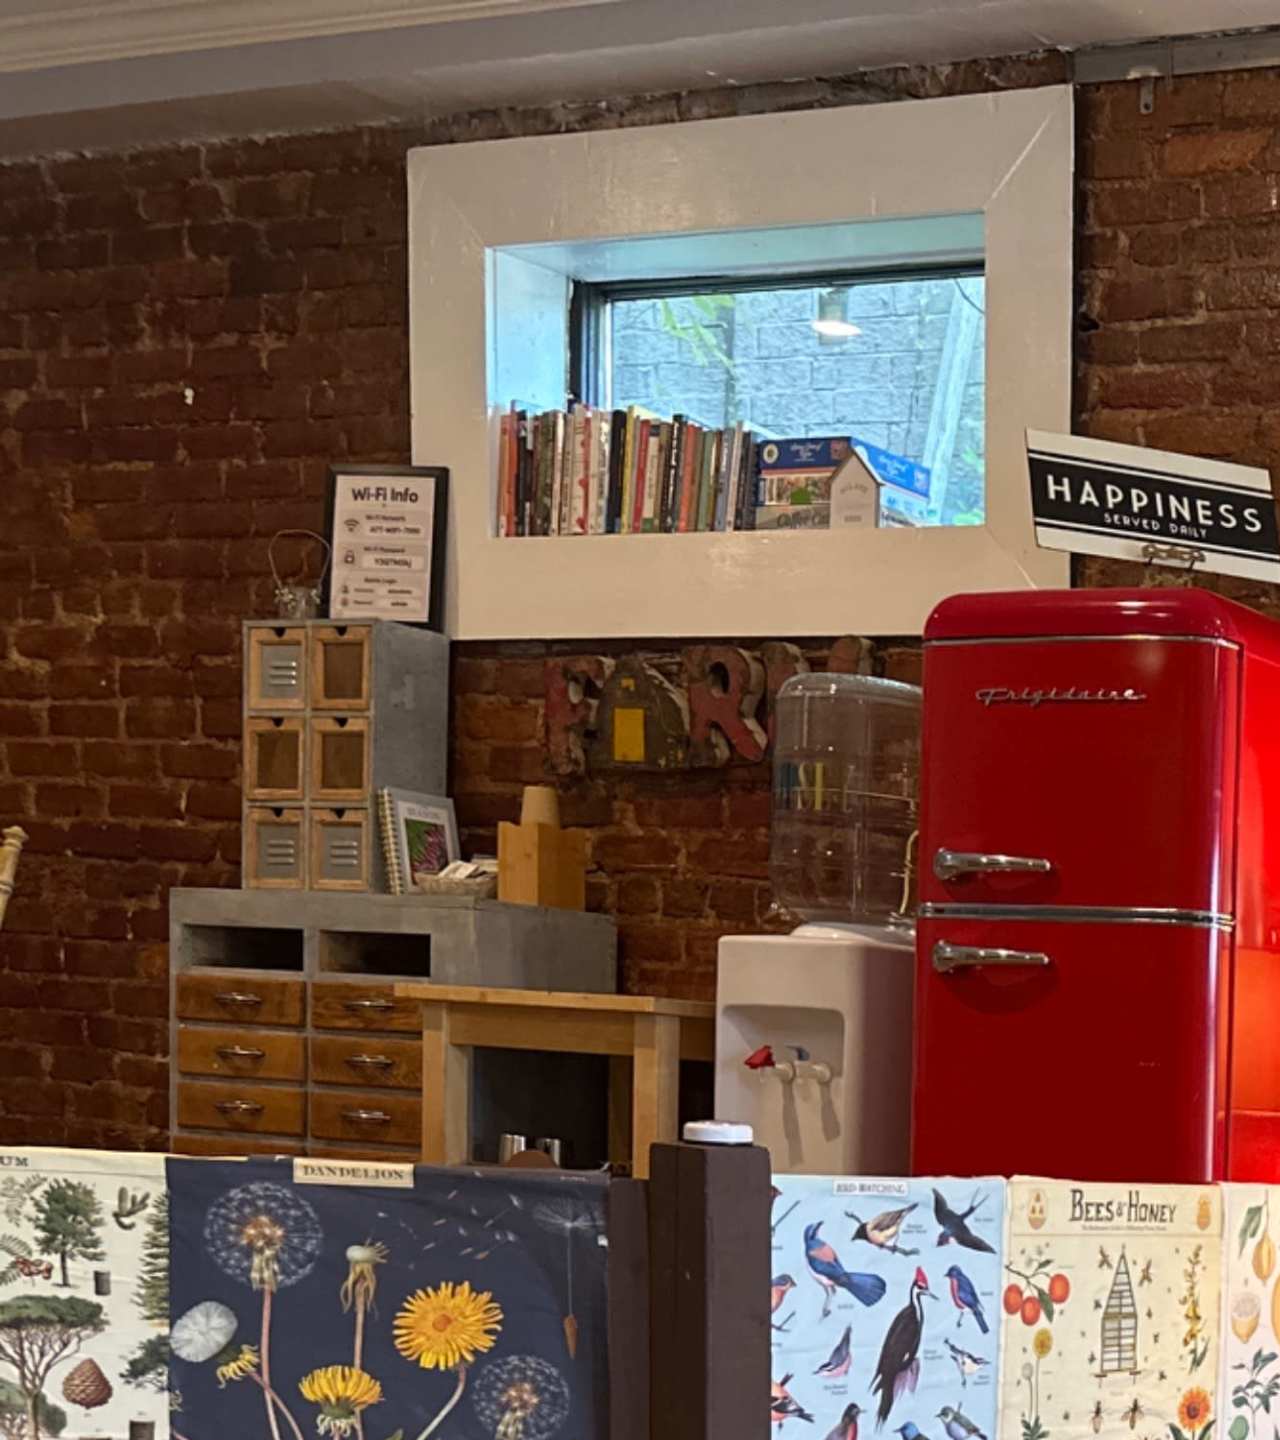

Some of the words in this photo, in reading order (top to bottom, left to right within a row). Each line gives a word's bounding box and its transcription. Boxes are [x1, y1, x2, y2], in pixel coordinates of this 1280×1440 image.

[390, 487, 419, 504] Info
[1045, 474, 1264, 533] HAPPINESS
[1103, 511, 1162, 531] SERVED
[1168, 522, 1209, 540] DAILY
[975, 687, 1148, 707] Frigidaire
[303, 1164, 404, 1181] DANDELION
